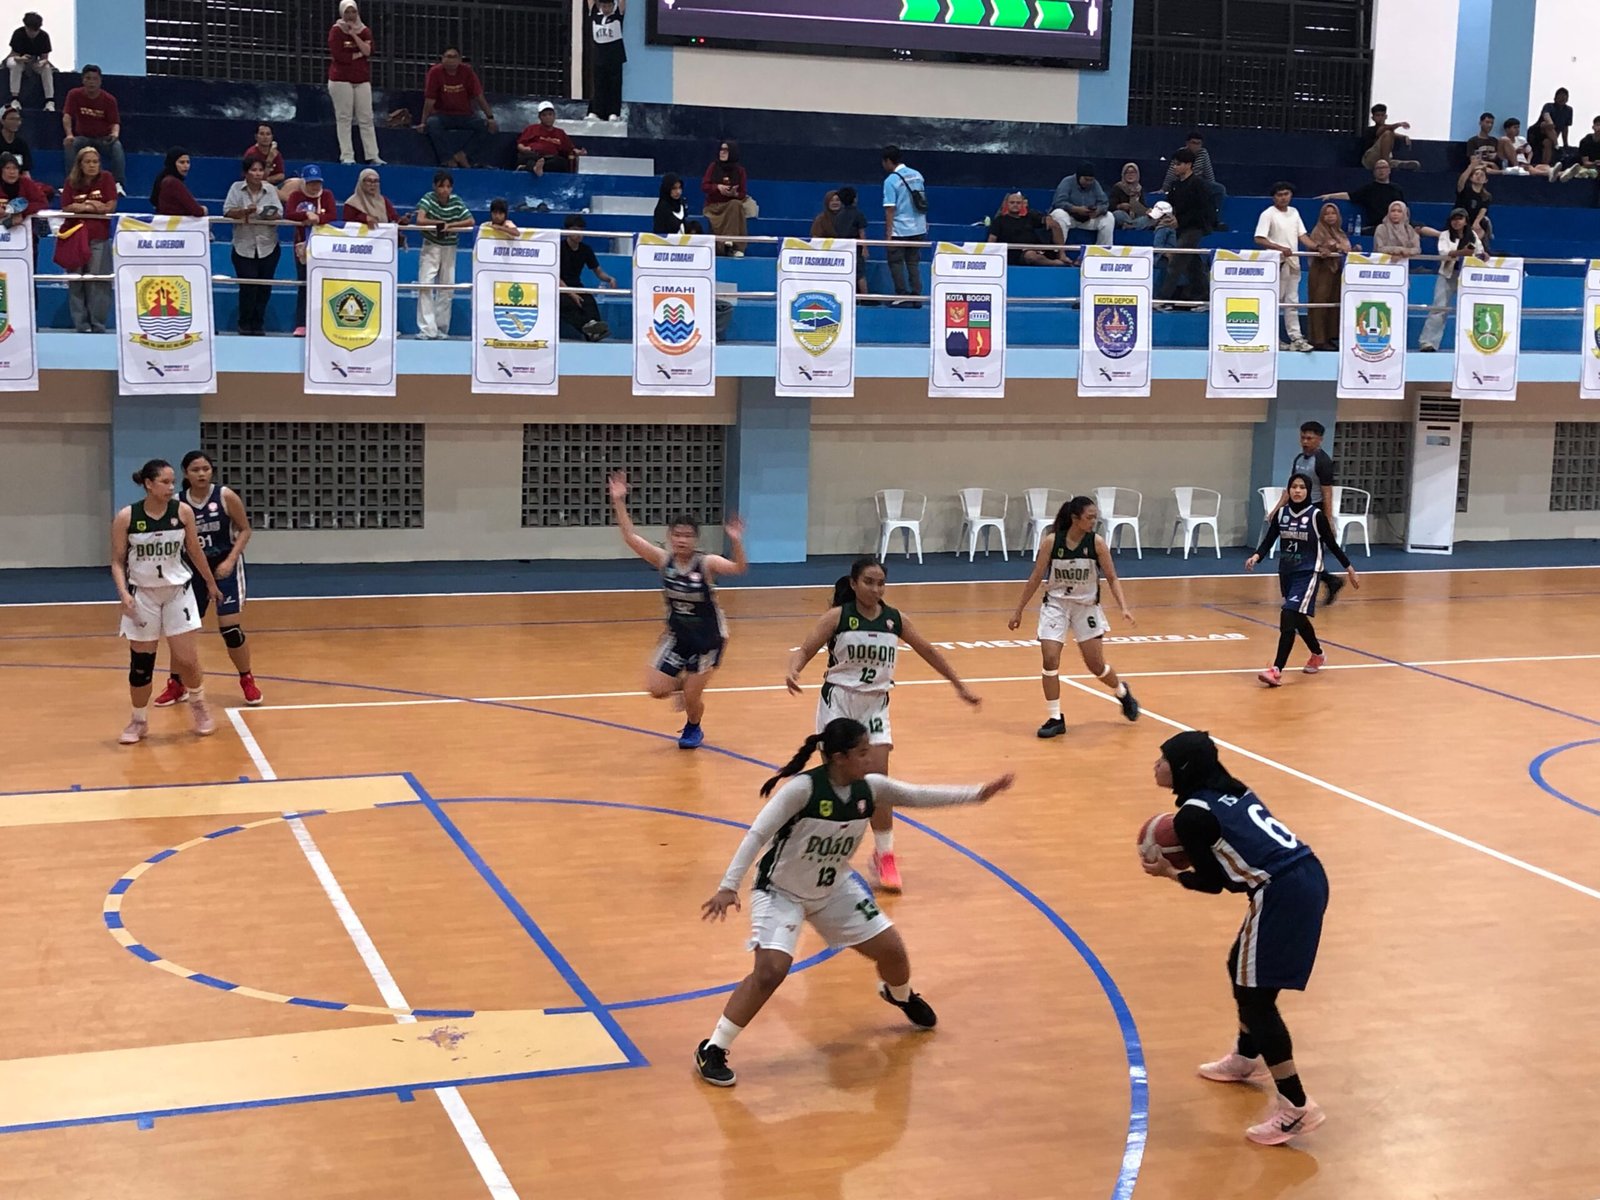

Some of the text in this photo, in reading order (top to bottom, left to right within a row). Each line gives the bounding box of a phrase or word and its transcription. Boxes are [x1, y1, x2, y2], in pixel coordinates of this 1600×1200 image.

[137, 239, 186, 249] KAB. CIREBON
[332, 243, 374, 255] KAB. BOGOR
[493, 246, 540, 258] KOTA CIREBON
[653, 252, 695, 263] KOTA CIMAHI
[788, 255, 846, 267] KOTA TASIKMALAYA
[1100, 263, 1134, 272] KOTA DEPOK
[652, 285, 696, 294] CIMAHI
[946, 294, 991, 302] KOTA BOGOR
[156, 564, 164, 579] 1
[183, 607, 191, 621] 1
[1087, 615, 1097, 629] 6
[847, 644, 896, 664] BOGOR
[859, 667, 877, 684] 12
[869, 716, 884, 734] 12
[1247, 803, 1298, 849] 6
[816, 866, 837, 887] 13
